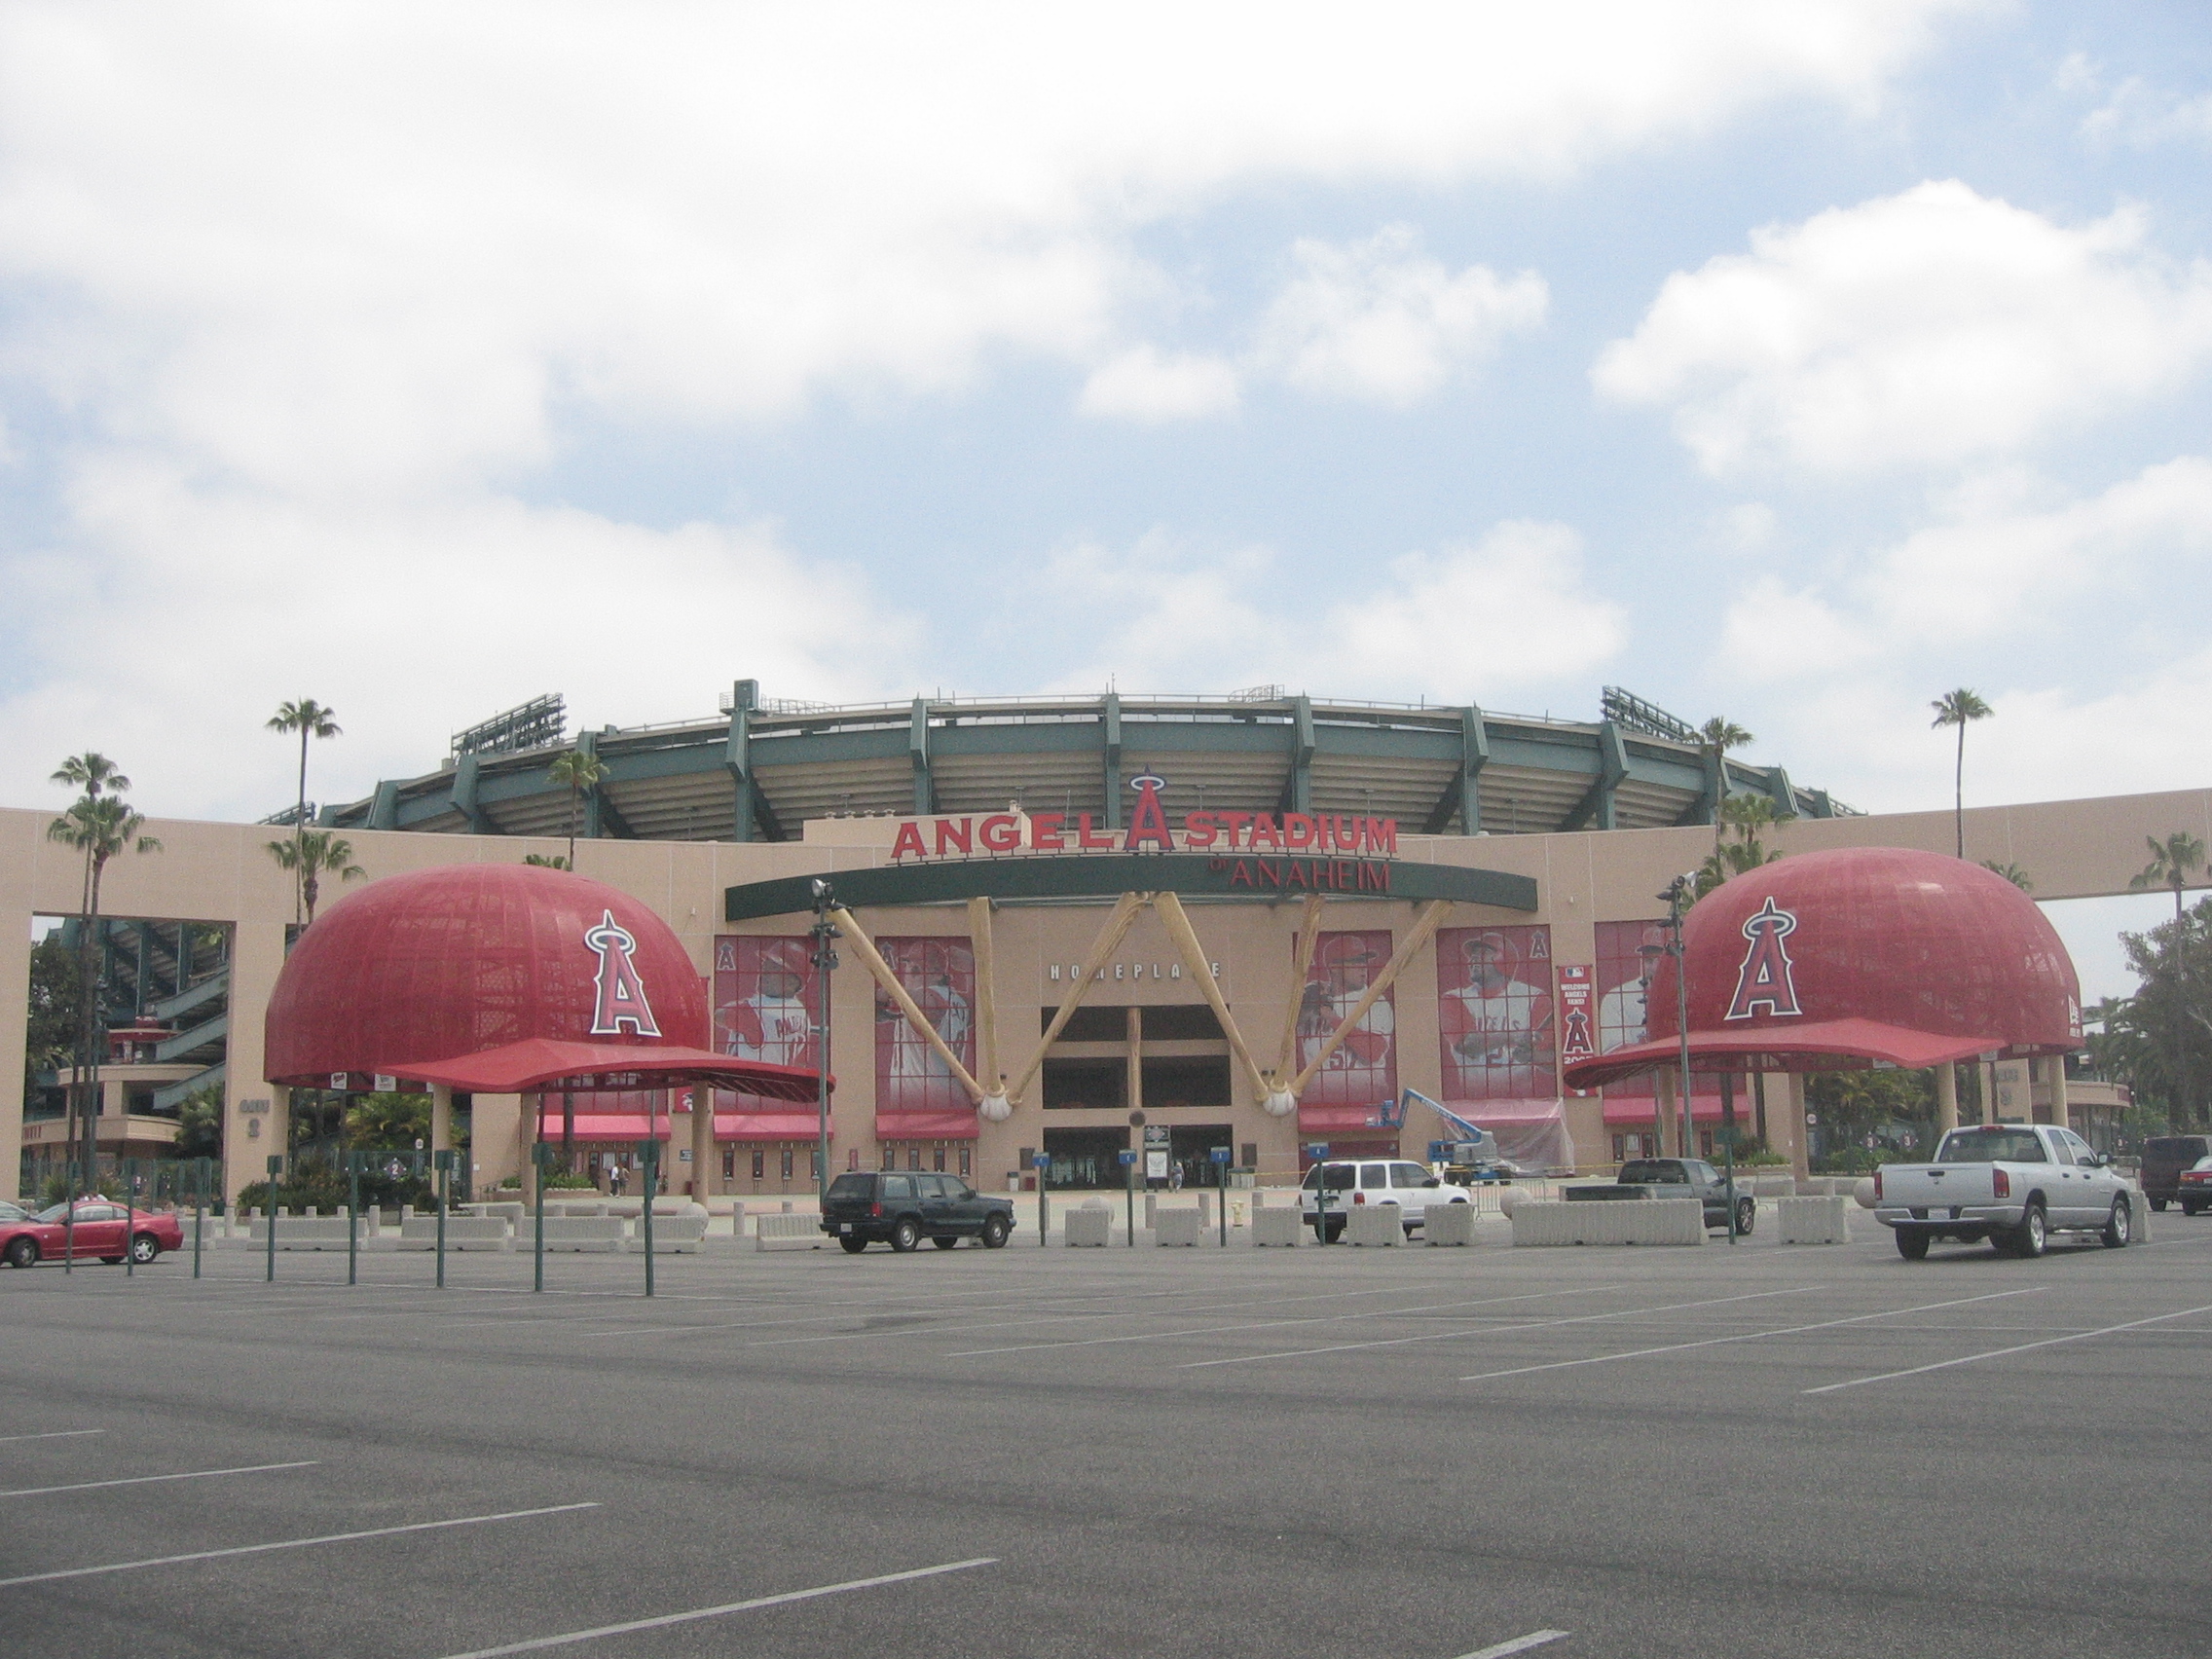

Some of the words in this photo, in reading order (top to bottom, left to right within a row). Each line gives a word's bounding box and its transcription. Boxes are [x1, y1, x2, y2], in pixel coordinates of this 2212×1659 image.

[891, 812, 1115, 859] ANGEL
[1123, 763, 1175, 851] A
[1184, 811, 1397, 853] STADIUM
[1230, 859, 1391, 892] ANAHEIM
[584, 908, 663, 1038] A
[1050, 962, 1220, 980] HOEPLAE
[1723, 896, 1803, 1020] A
